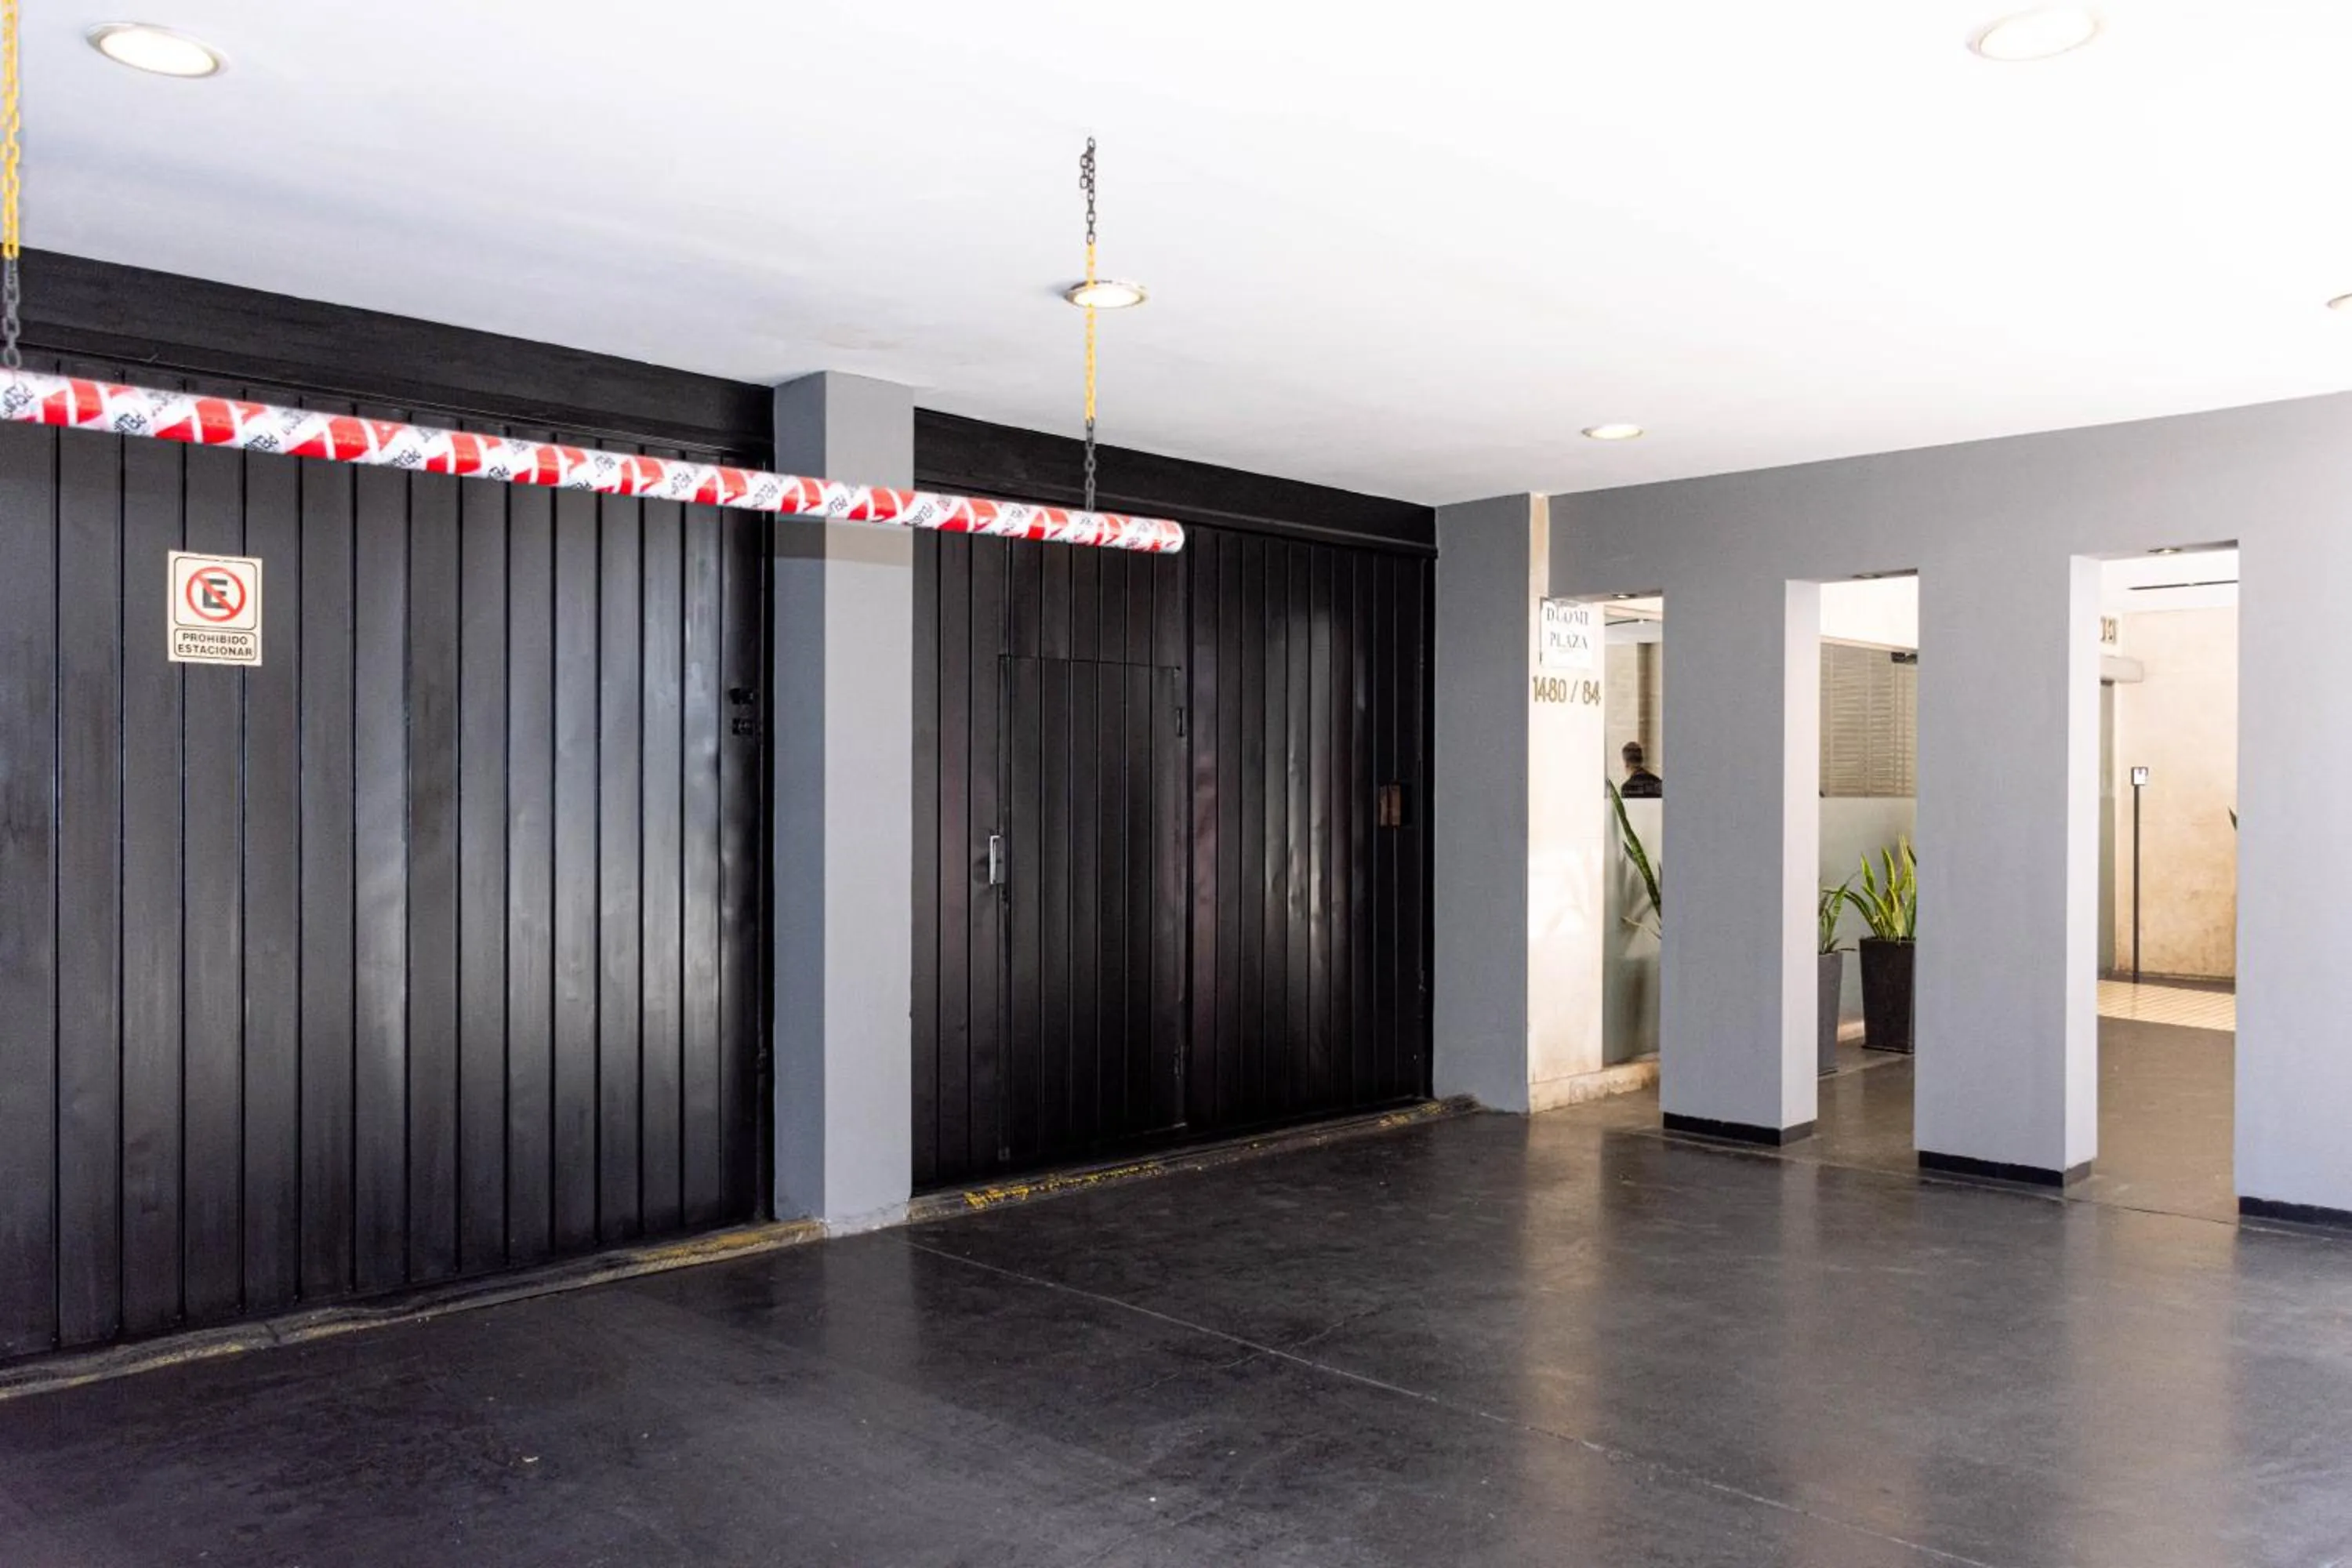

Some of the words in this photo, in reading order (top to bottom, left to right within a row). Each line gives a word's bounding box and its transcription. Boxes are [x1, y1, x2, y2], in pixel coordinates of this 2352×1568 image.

[182, 633, 248, 644] PROHIBIDO
[1550, 631, 1588, 649] PLAZA
[177, 644, 252, 656] ESTACIONAR
